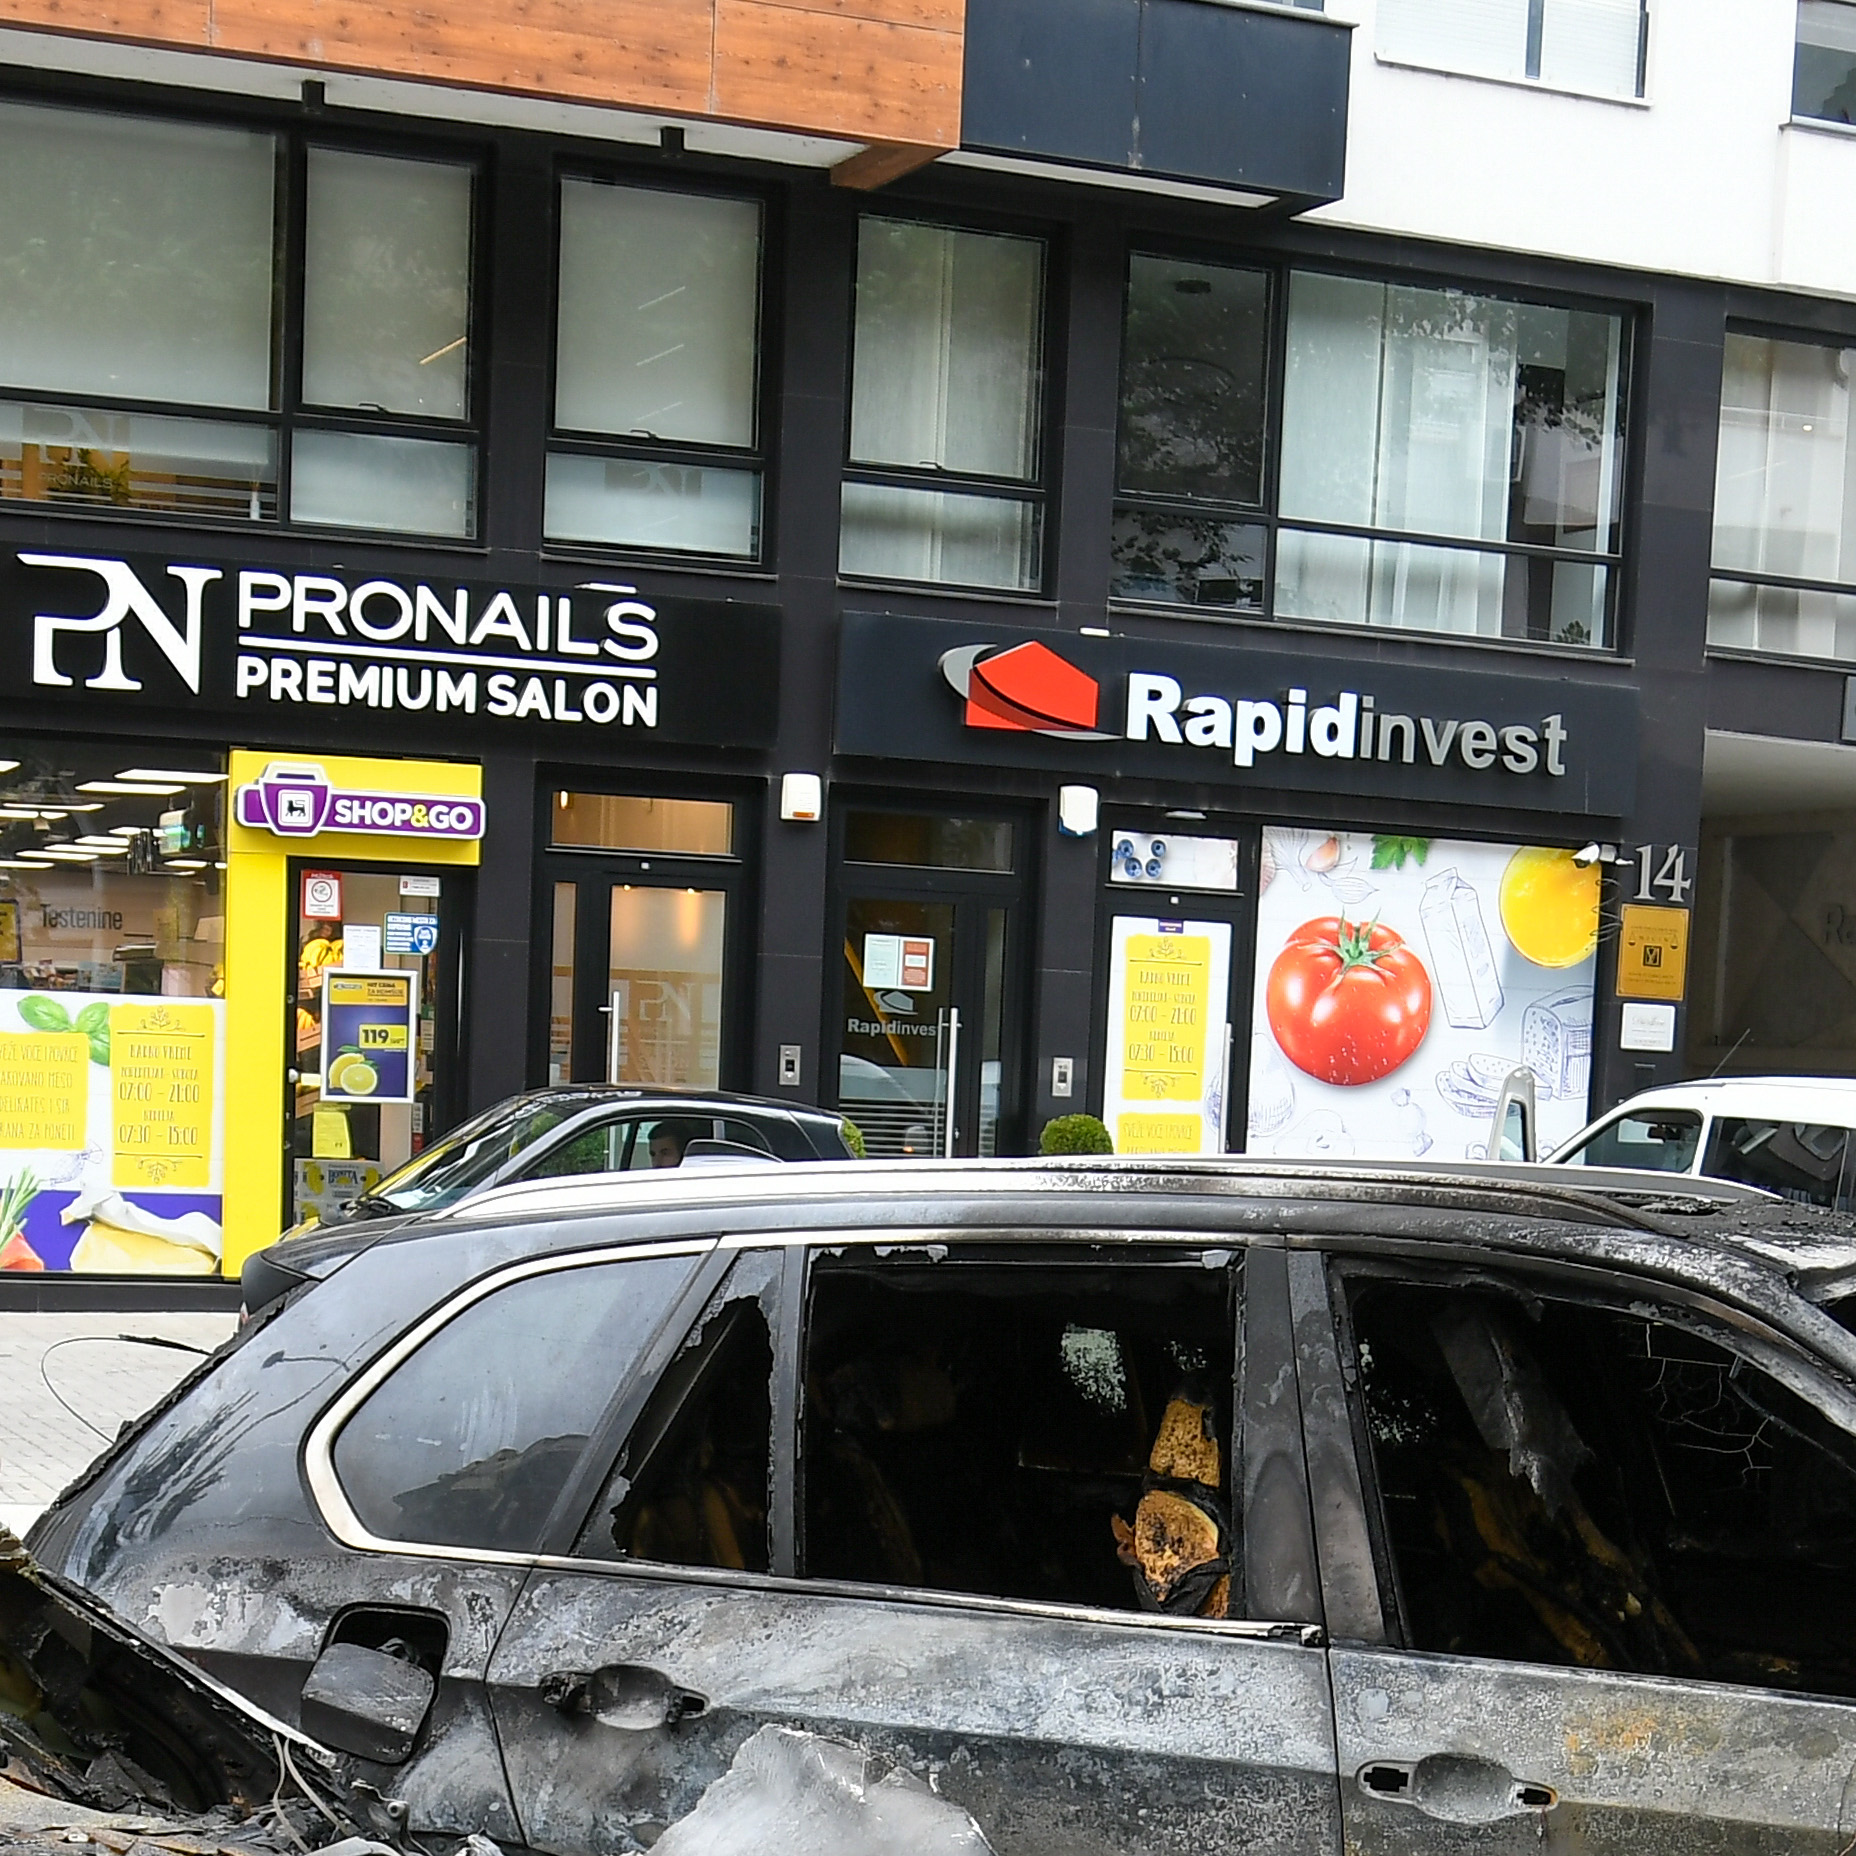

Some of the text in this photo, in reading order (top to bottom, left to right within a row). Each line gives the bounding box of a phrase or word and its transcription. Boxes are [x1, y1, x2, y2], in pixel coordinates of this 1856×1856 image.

[33, 407, 123, 467] PN
[38, 473, 113, 489] PRONAILS
[16, 553, 223, 694] PN
[238, 570, 659, 661] PRONAILS
[236, 655, 659, 728] PREMIUM SALON
[1125, 672, 1568, 776] Rapidinvest
[334, 798, 474, 832] SHOP&GO
[1632, 843, 1693, 903] 14
[40, 903, 124, 931] Testenine
[362, 1028, 390, 1044] 119
[847, 1018, 939, 1037] Rapidinves
[119, 1082, 153, 1102] 07:00
[168, 1083, 200, 1103] 21:00
[28, 1122, 40, 1139] ZA
[119, 1124, 151, 1144] 07:30
[168, 1125, 198, 1146] 15:00
